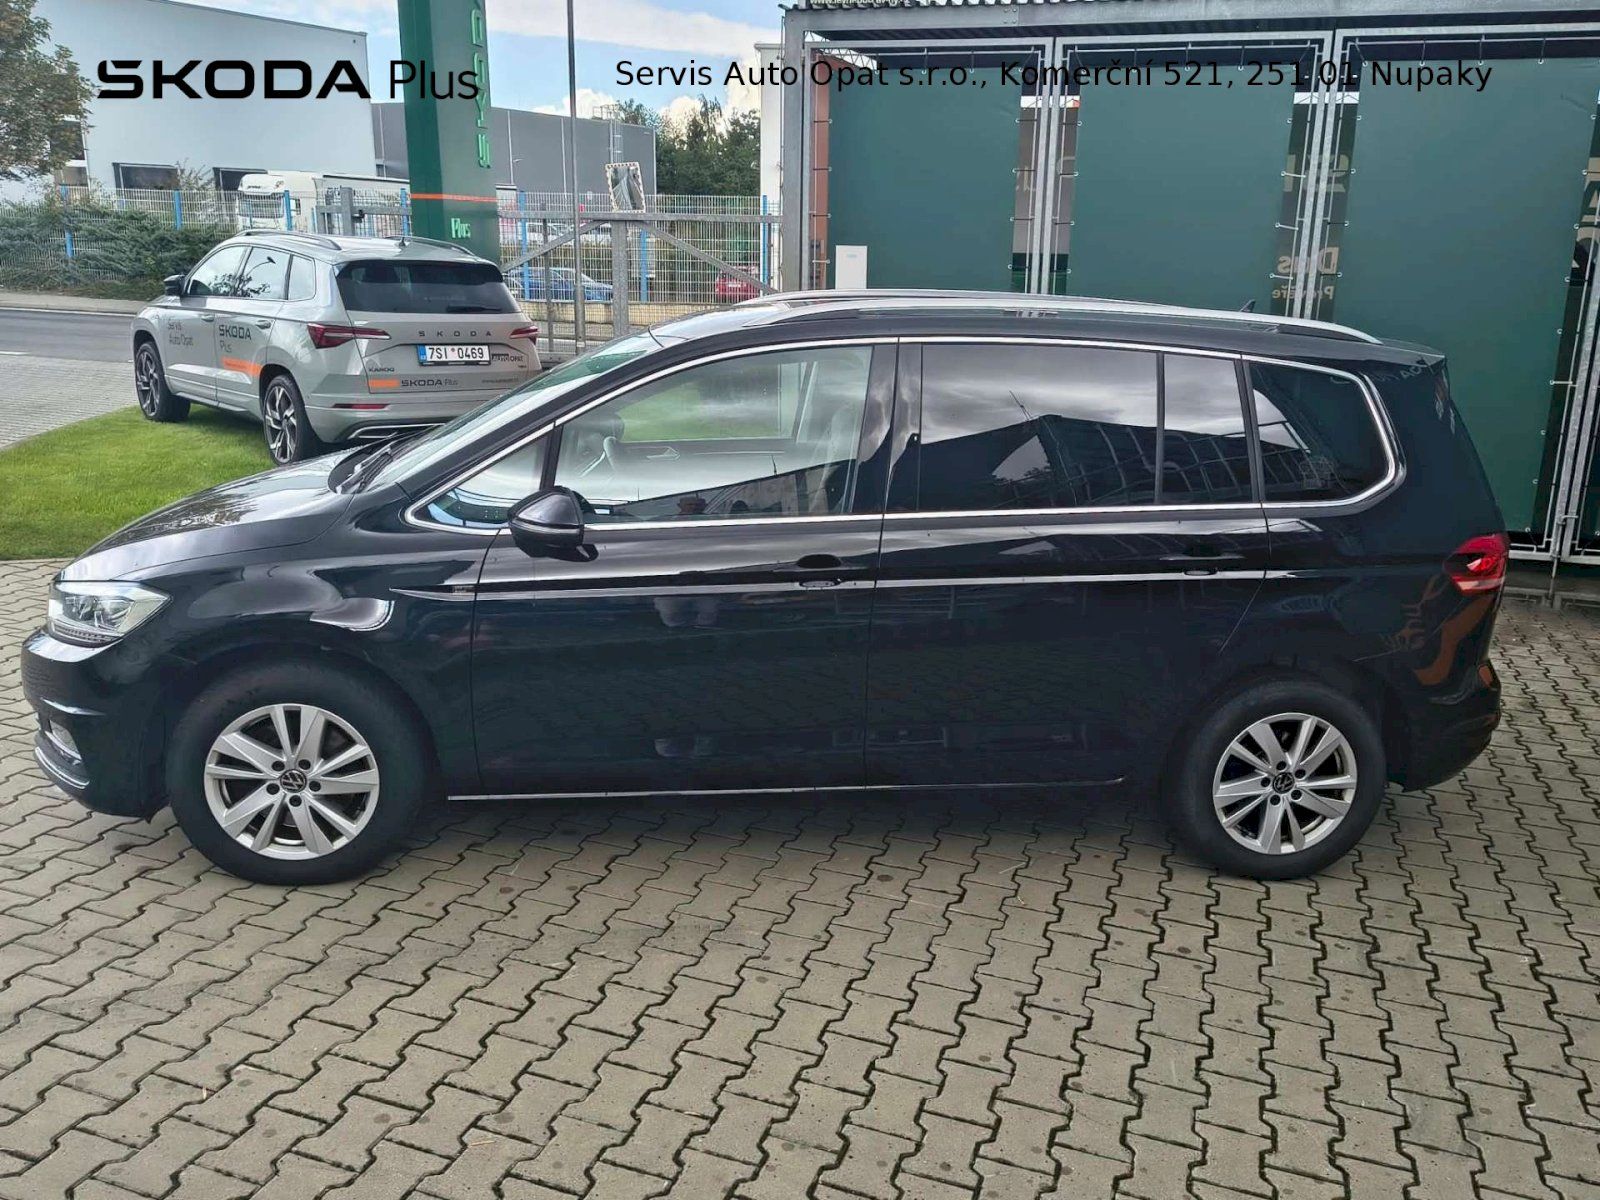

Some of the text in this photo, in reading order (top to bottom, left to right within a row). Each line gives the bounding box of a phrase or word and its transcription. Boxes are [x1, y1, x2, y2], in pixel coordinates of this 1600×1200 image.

[451, 217, 471, 239] Plus
[428, 346, 484, 361] 7SI 0469
